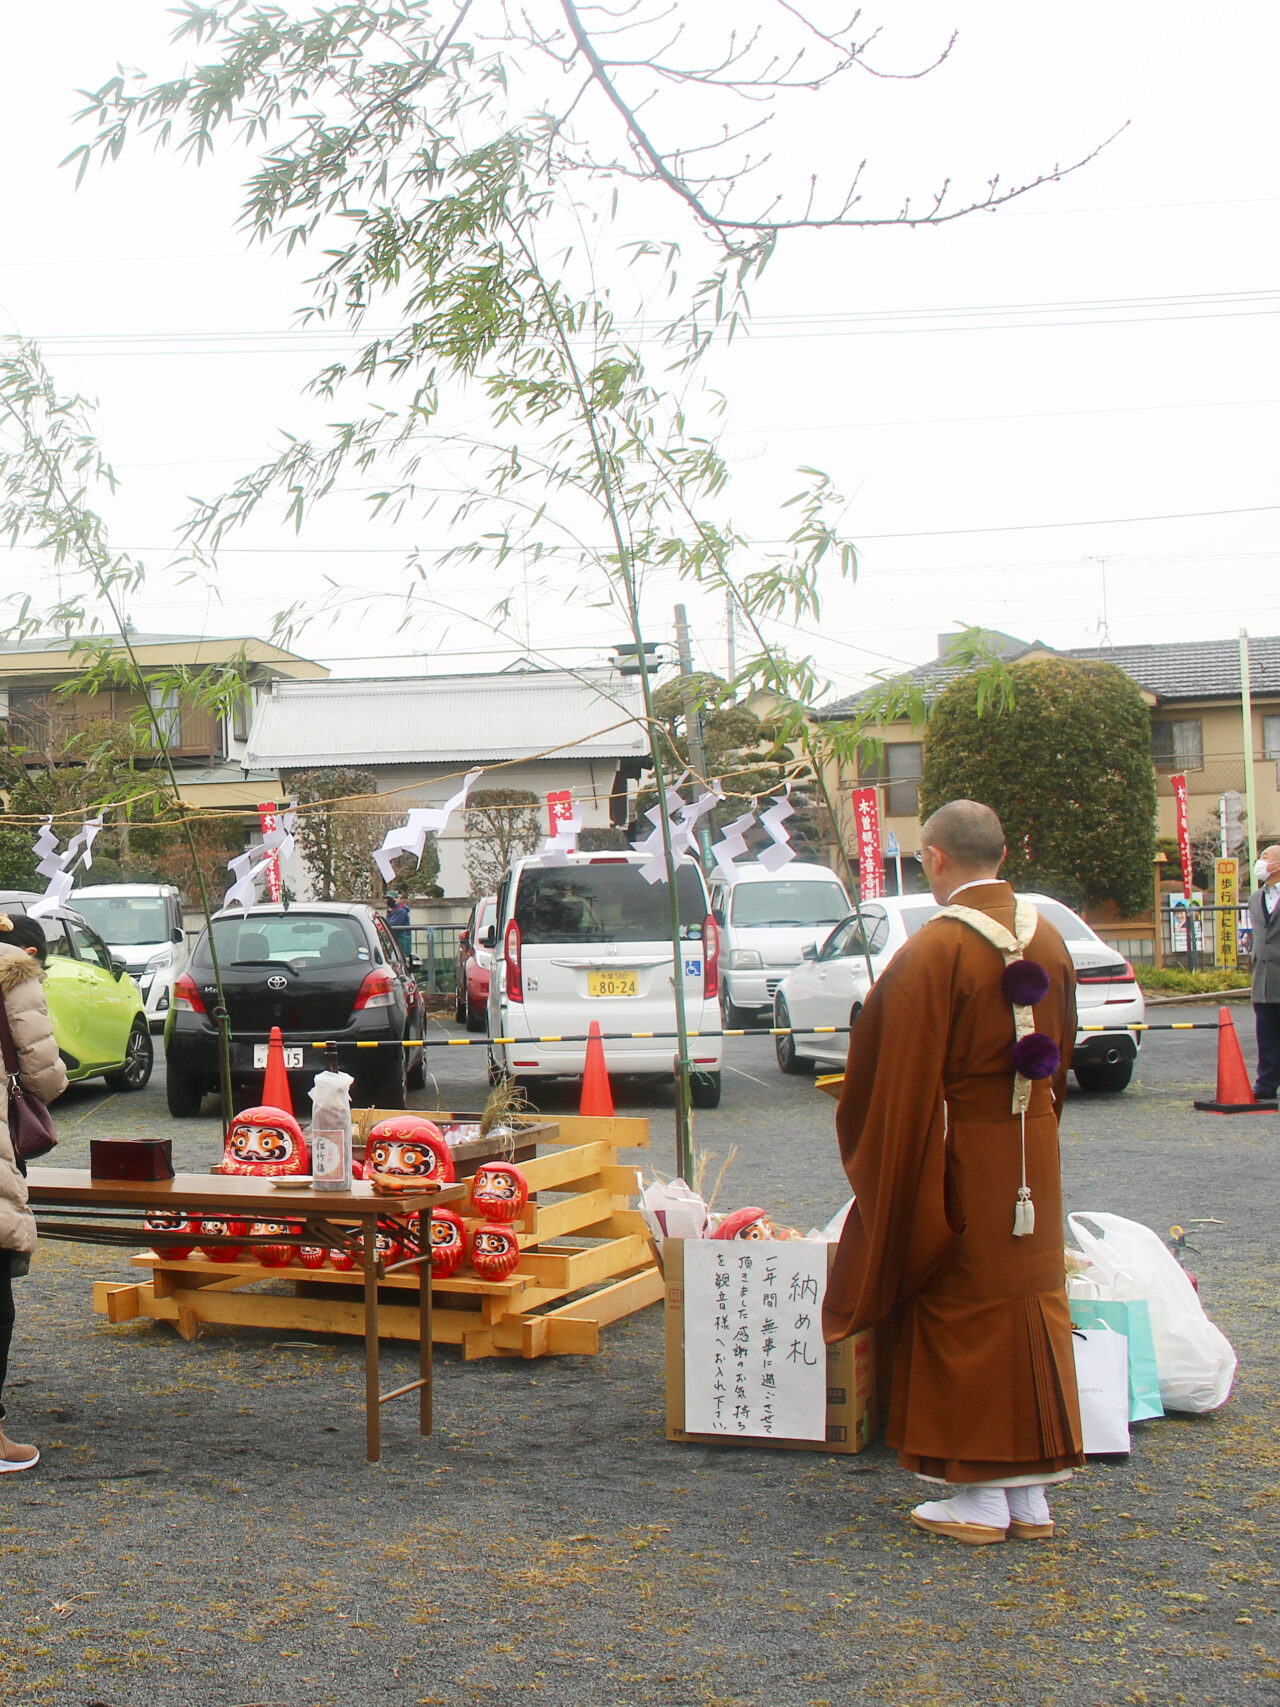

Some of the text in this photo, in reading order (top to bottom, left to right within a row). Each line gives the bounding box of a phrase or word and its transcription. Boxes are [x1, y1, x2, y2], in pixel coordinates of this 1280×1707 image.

[599, 981, 636, 994] 80-24
[732, 1256, 753, 1431] 頂きました感謝のお気持ち
[786, 1272, 818, 1365] 納め札
